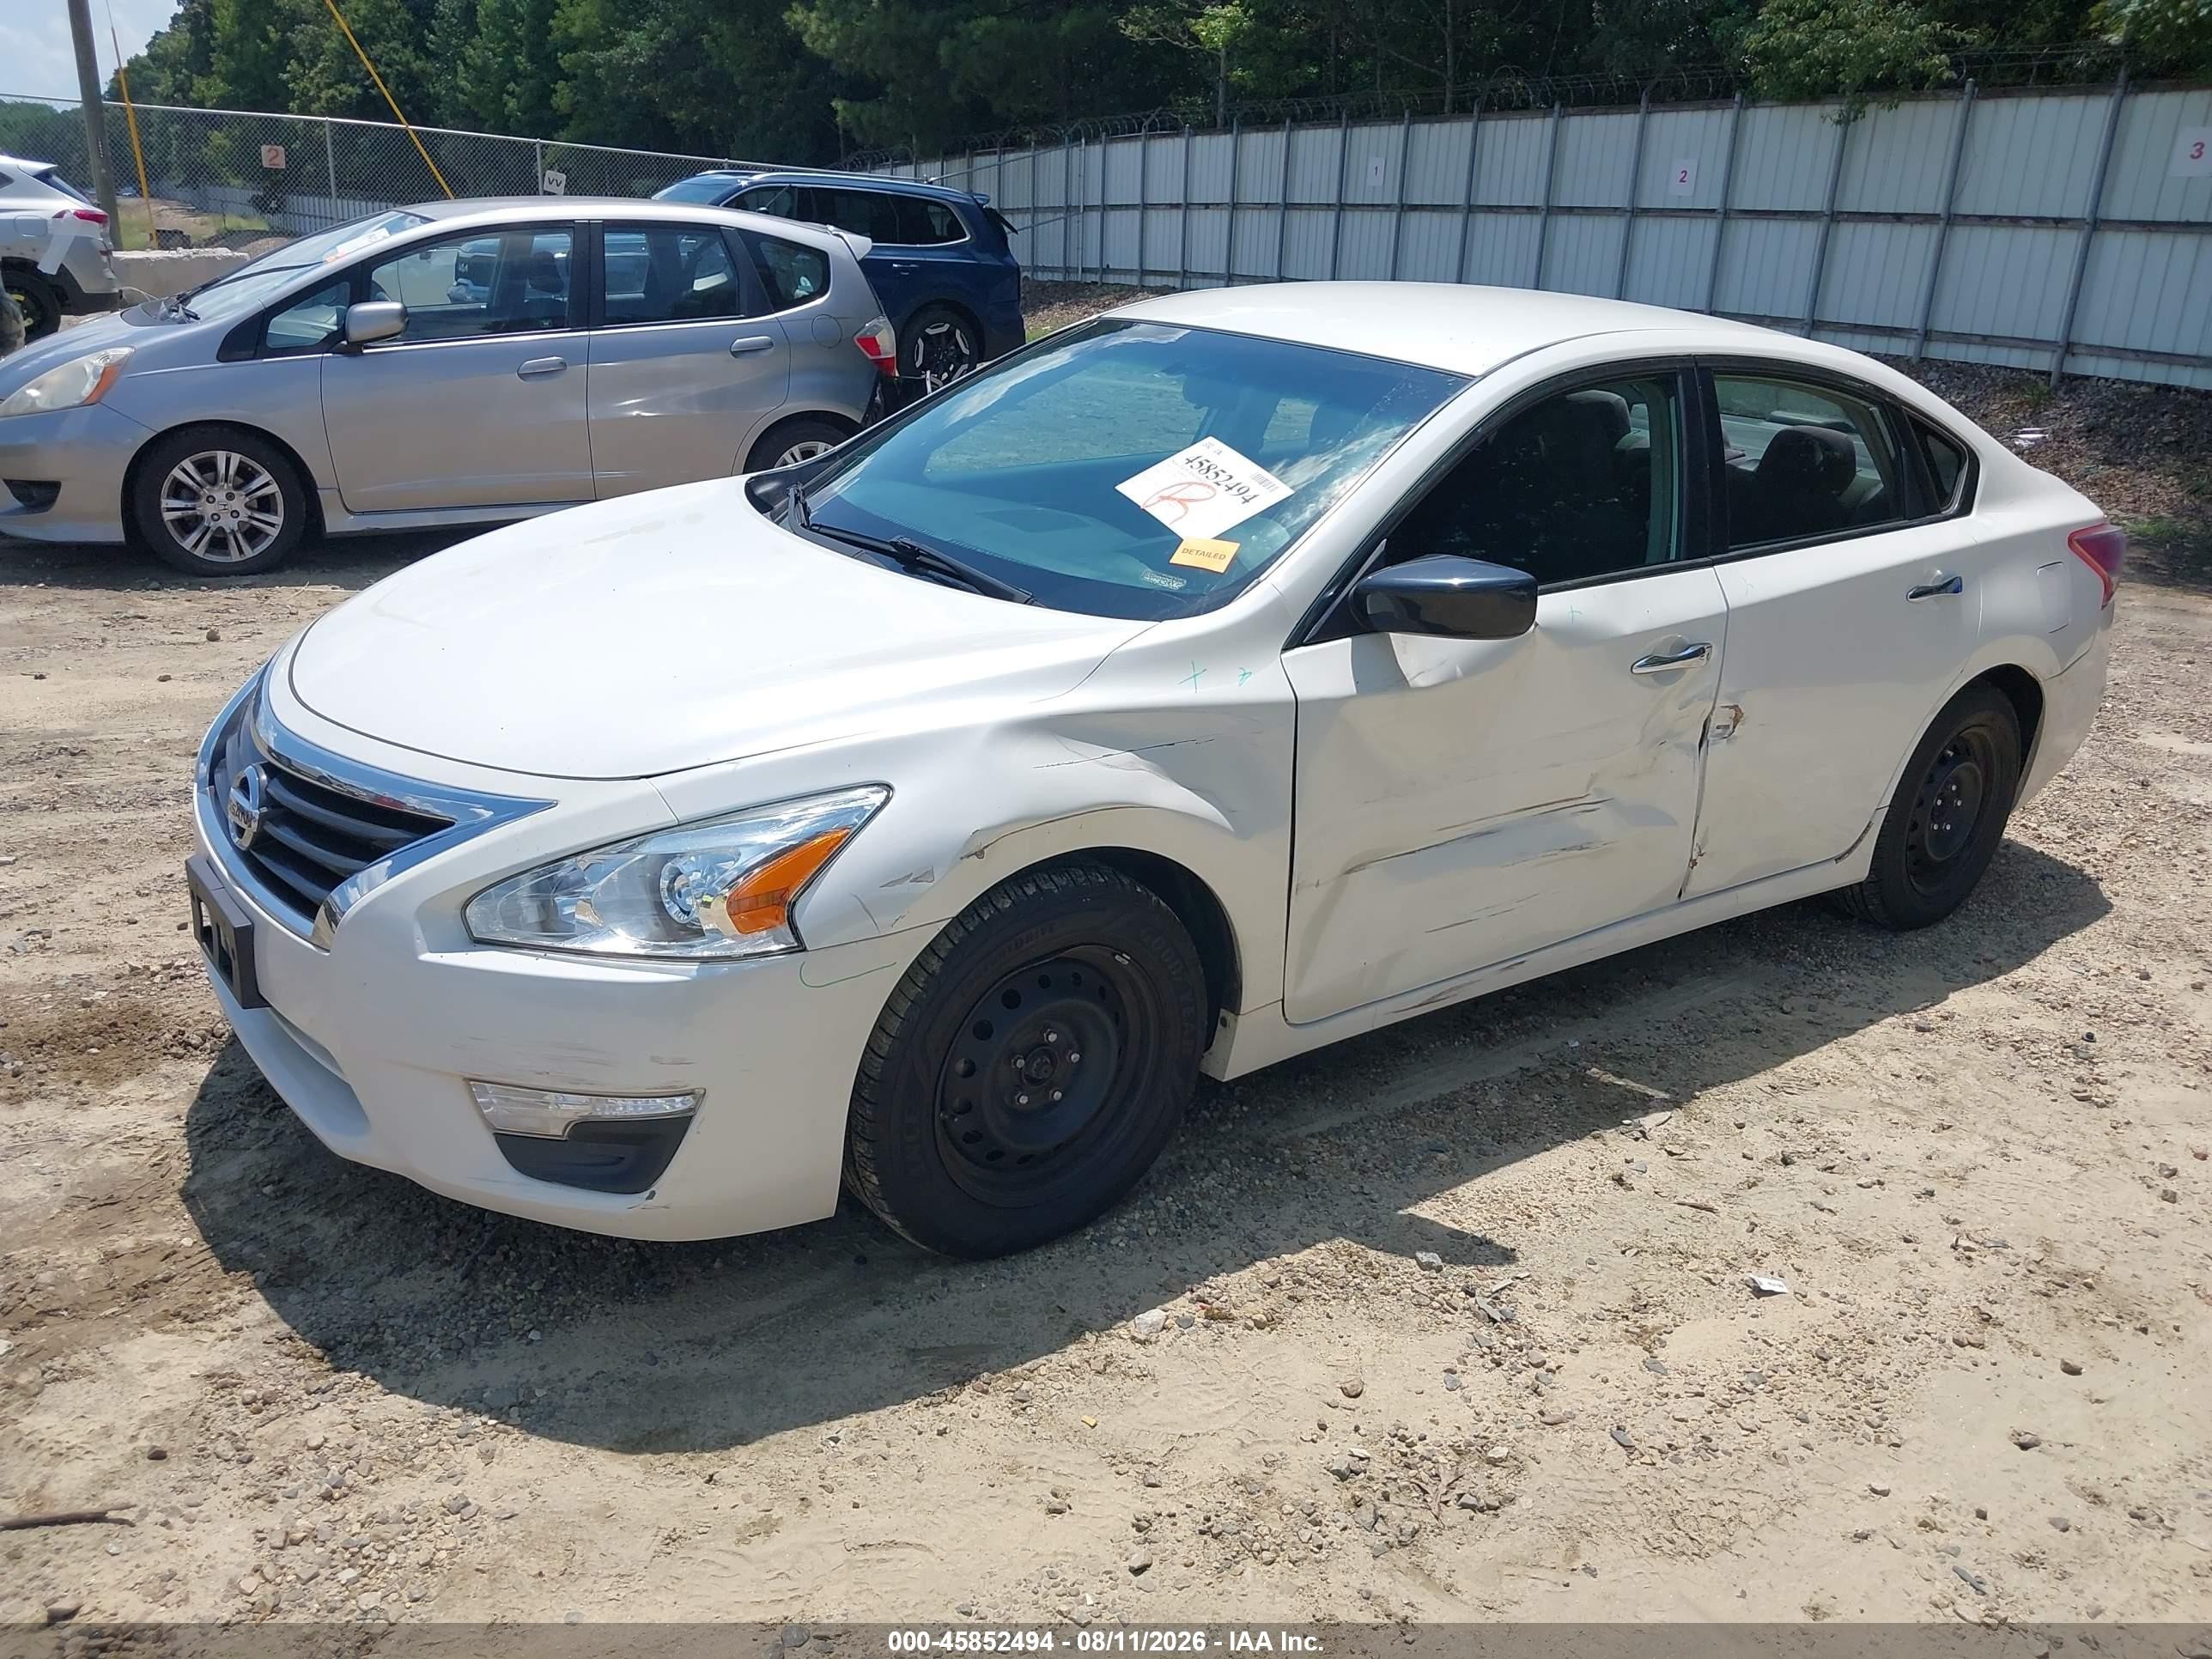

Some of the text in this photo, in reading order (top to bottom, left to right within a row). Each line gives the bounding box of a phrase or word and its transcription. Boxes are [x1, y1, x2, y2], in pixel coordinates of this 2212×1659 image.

[268, 148, 281, 167] 2
[2190, 142, 2206, 160] 3
[1679, 170, 1688, 183] 2
[1185, 455, 1260, 505] 45852494
[1182, 548, 1227, 560] DETAILED
